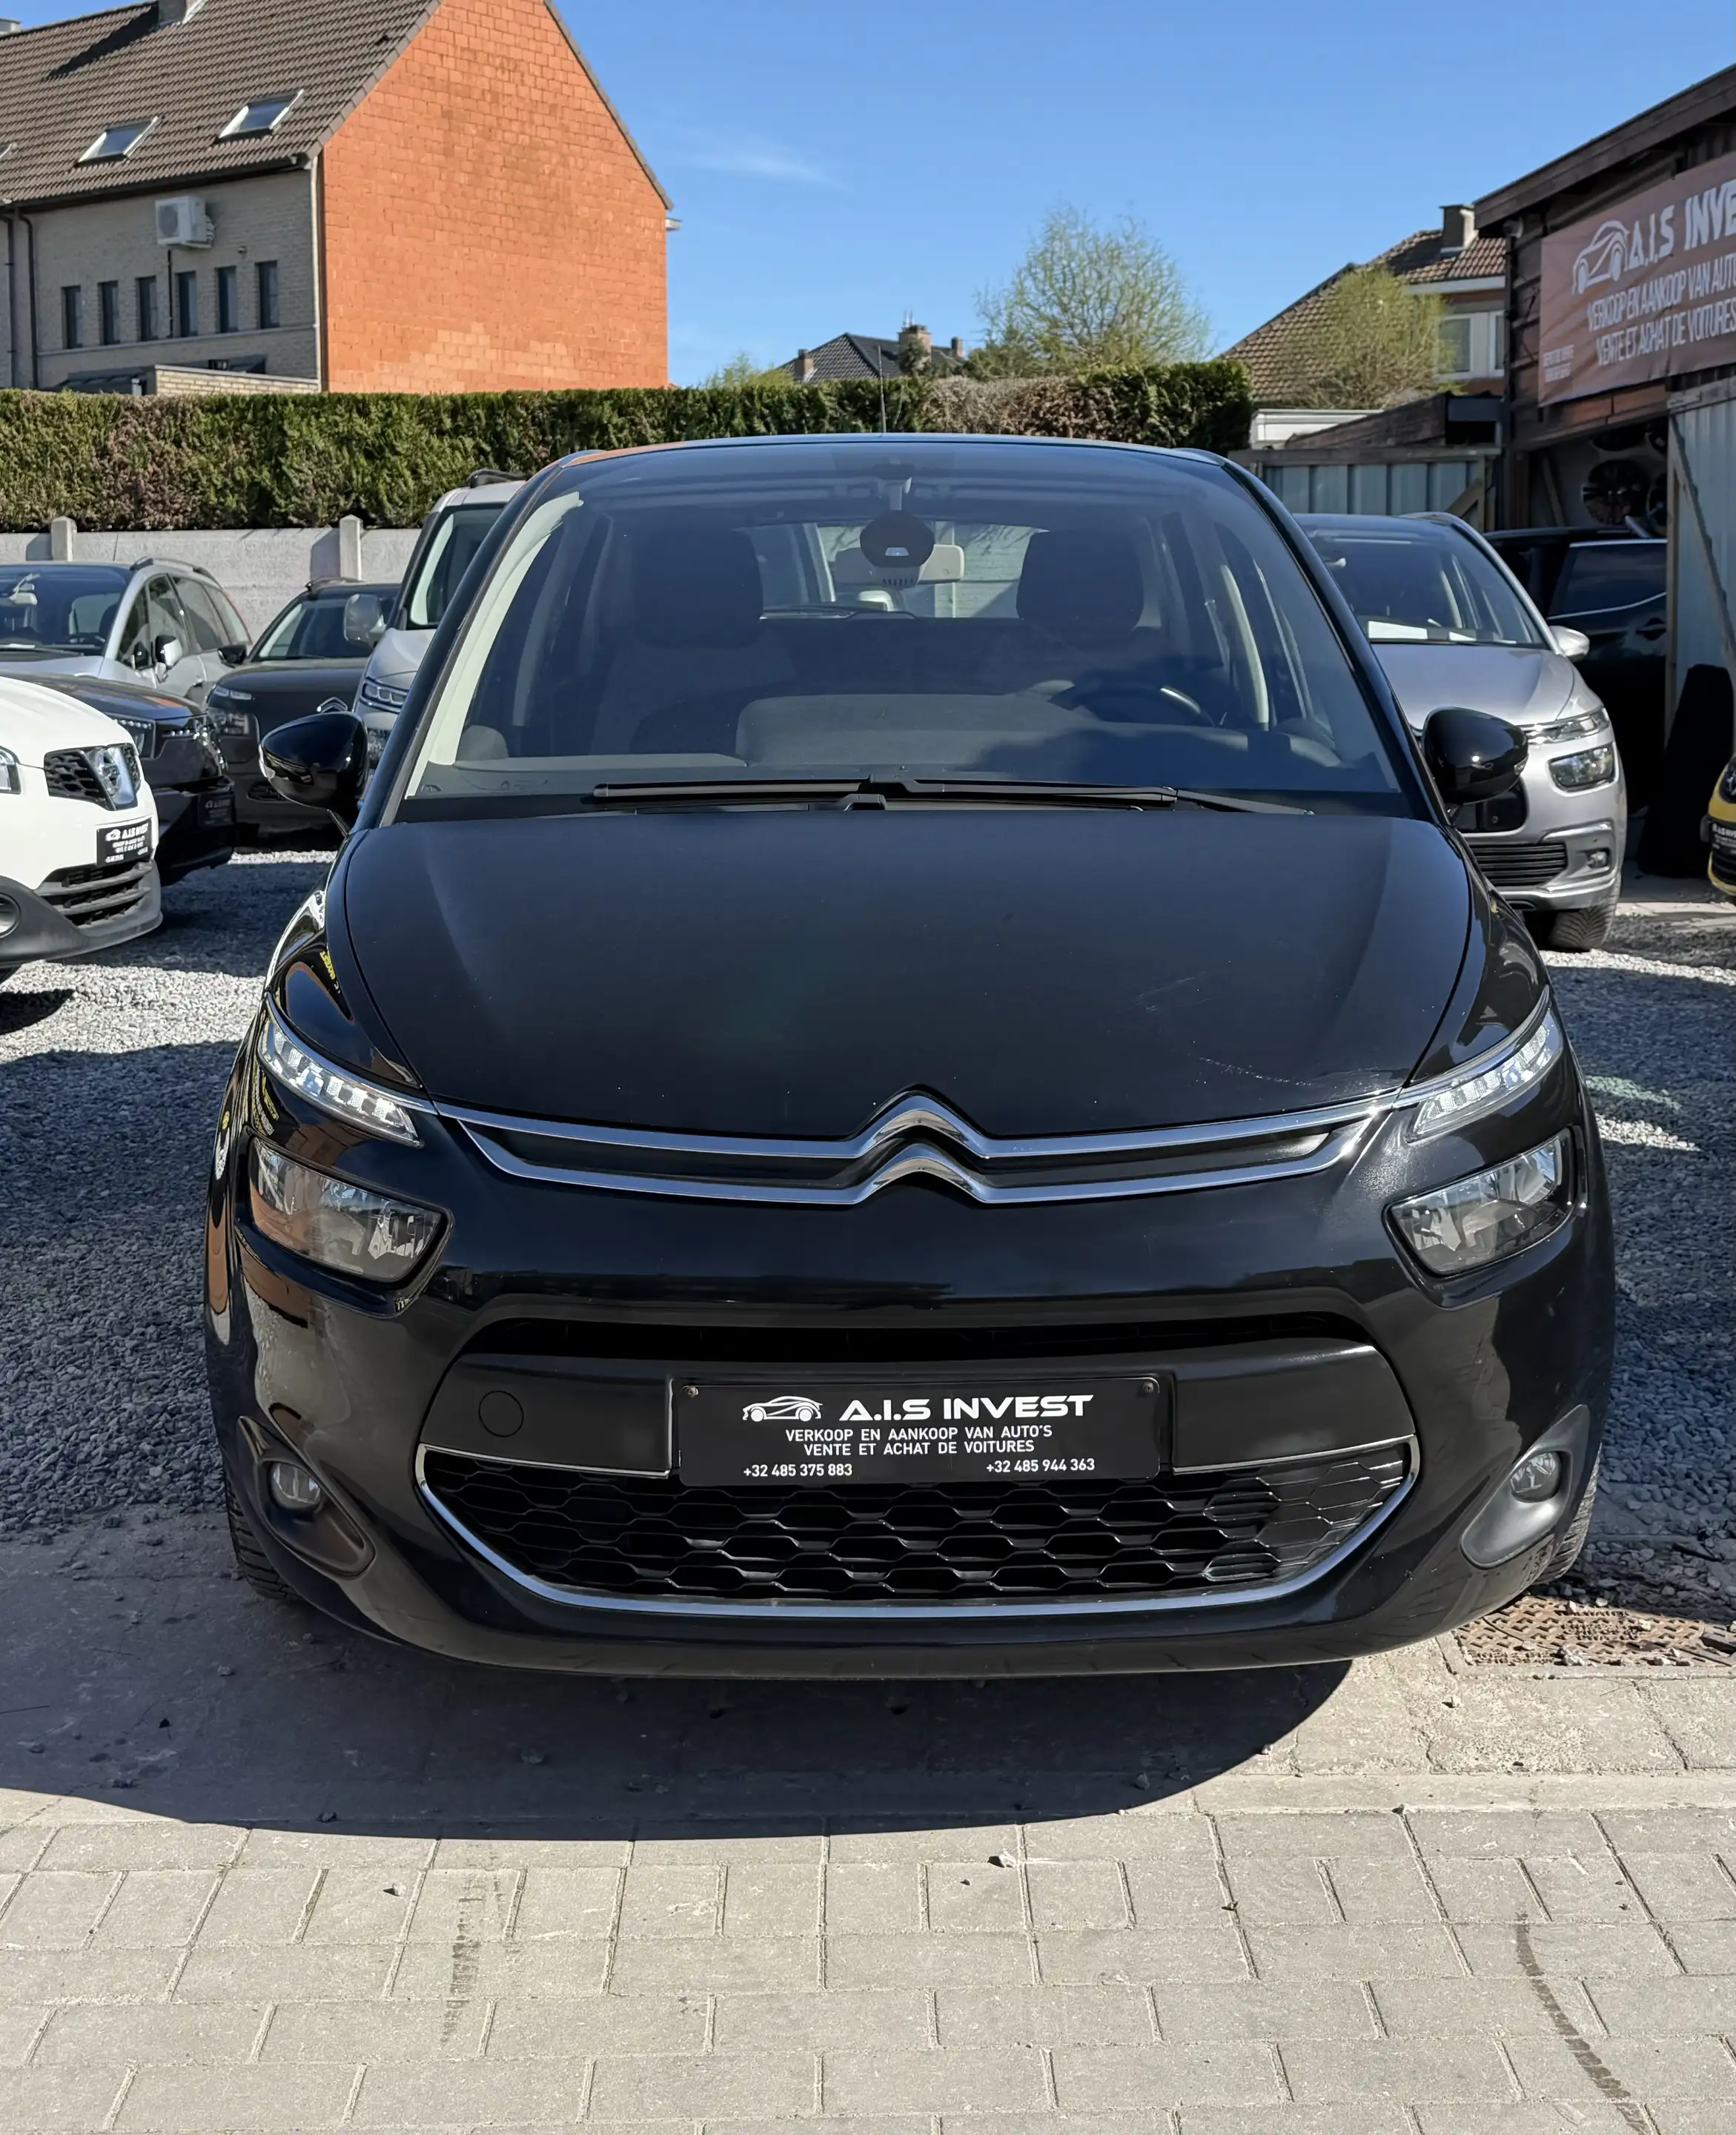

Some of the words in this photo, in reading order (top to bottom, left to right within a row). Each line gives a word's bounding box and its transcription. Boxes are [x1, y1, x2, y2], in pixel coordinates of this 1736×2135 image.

[1688, 261, 1711, 300] VAN
[1672, 312, 1686, 346] DE
[839, 1399, 931, 1421] A.I.S
[943, 1394, 1094, 1420] INVEST
[785, 1429, 854, 1442] VERKOOP
[861, 1429, 881, 1441] EN
[888, 1427, 958, 1441] AANKOOP
[964, 1426, 994, 1440] VAN
[1001, 1424, 1053, 1438] AUTO'S
[804, 1443, 852, 1457] VENTE
[858, 1443, 877, 1456] ET
[883, 1442, 931, 1455] ACHAT
[938, 1441, 958, 1454] DE
[964, 1439, 1035, 1454] VOITURES
[743, 1464, 769, 1477] +32
[771, 1463, 797, 1477] 485
[800, 1463, 825, 1477] 375
[827, 1463, 853, 1477] 883
[986, 1460, 1011, 1473] +32
[1013, 1459, 1039, 1473] 485
[1042, 1458, 1067, 1472] 944
[1070, 1457, 1096, 1472] 363
